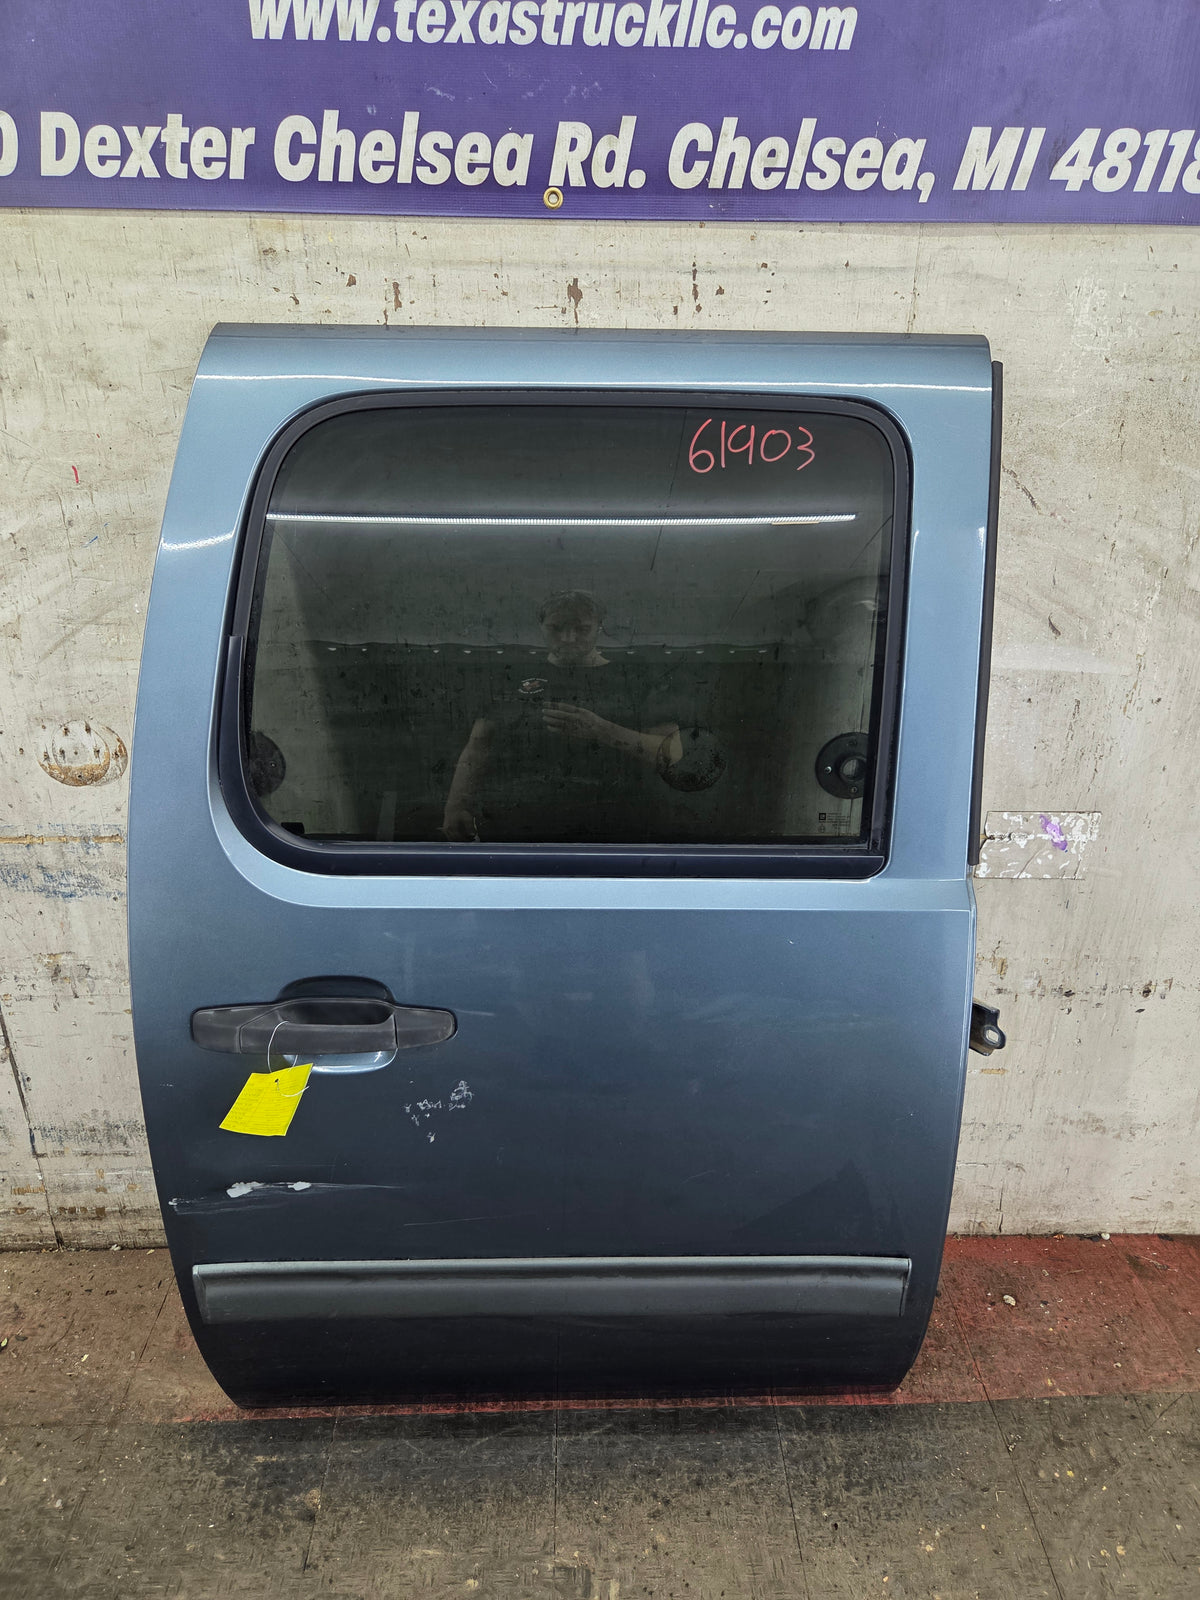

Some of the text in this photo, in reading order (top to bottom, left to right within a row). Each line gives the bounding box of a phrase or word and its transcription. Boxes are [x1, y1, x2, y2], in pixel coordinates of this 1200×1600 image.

[40, 111, 256, 180] Dexter
[274, 110, 534, 186] Chelsea
[549, 116, 646, 189] Rd.
[668, 117, 935, 203] Chelsea,
[953, 127, 1046, 191] MI
[689, 418, 815, 473] 61903
